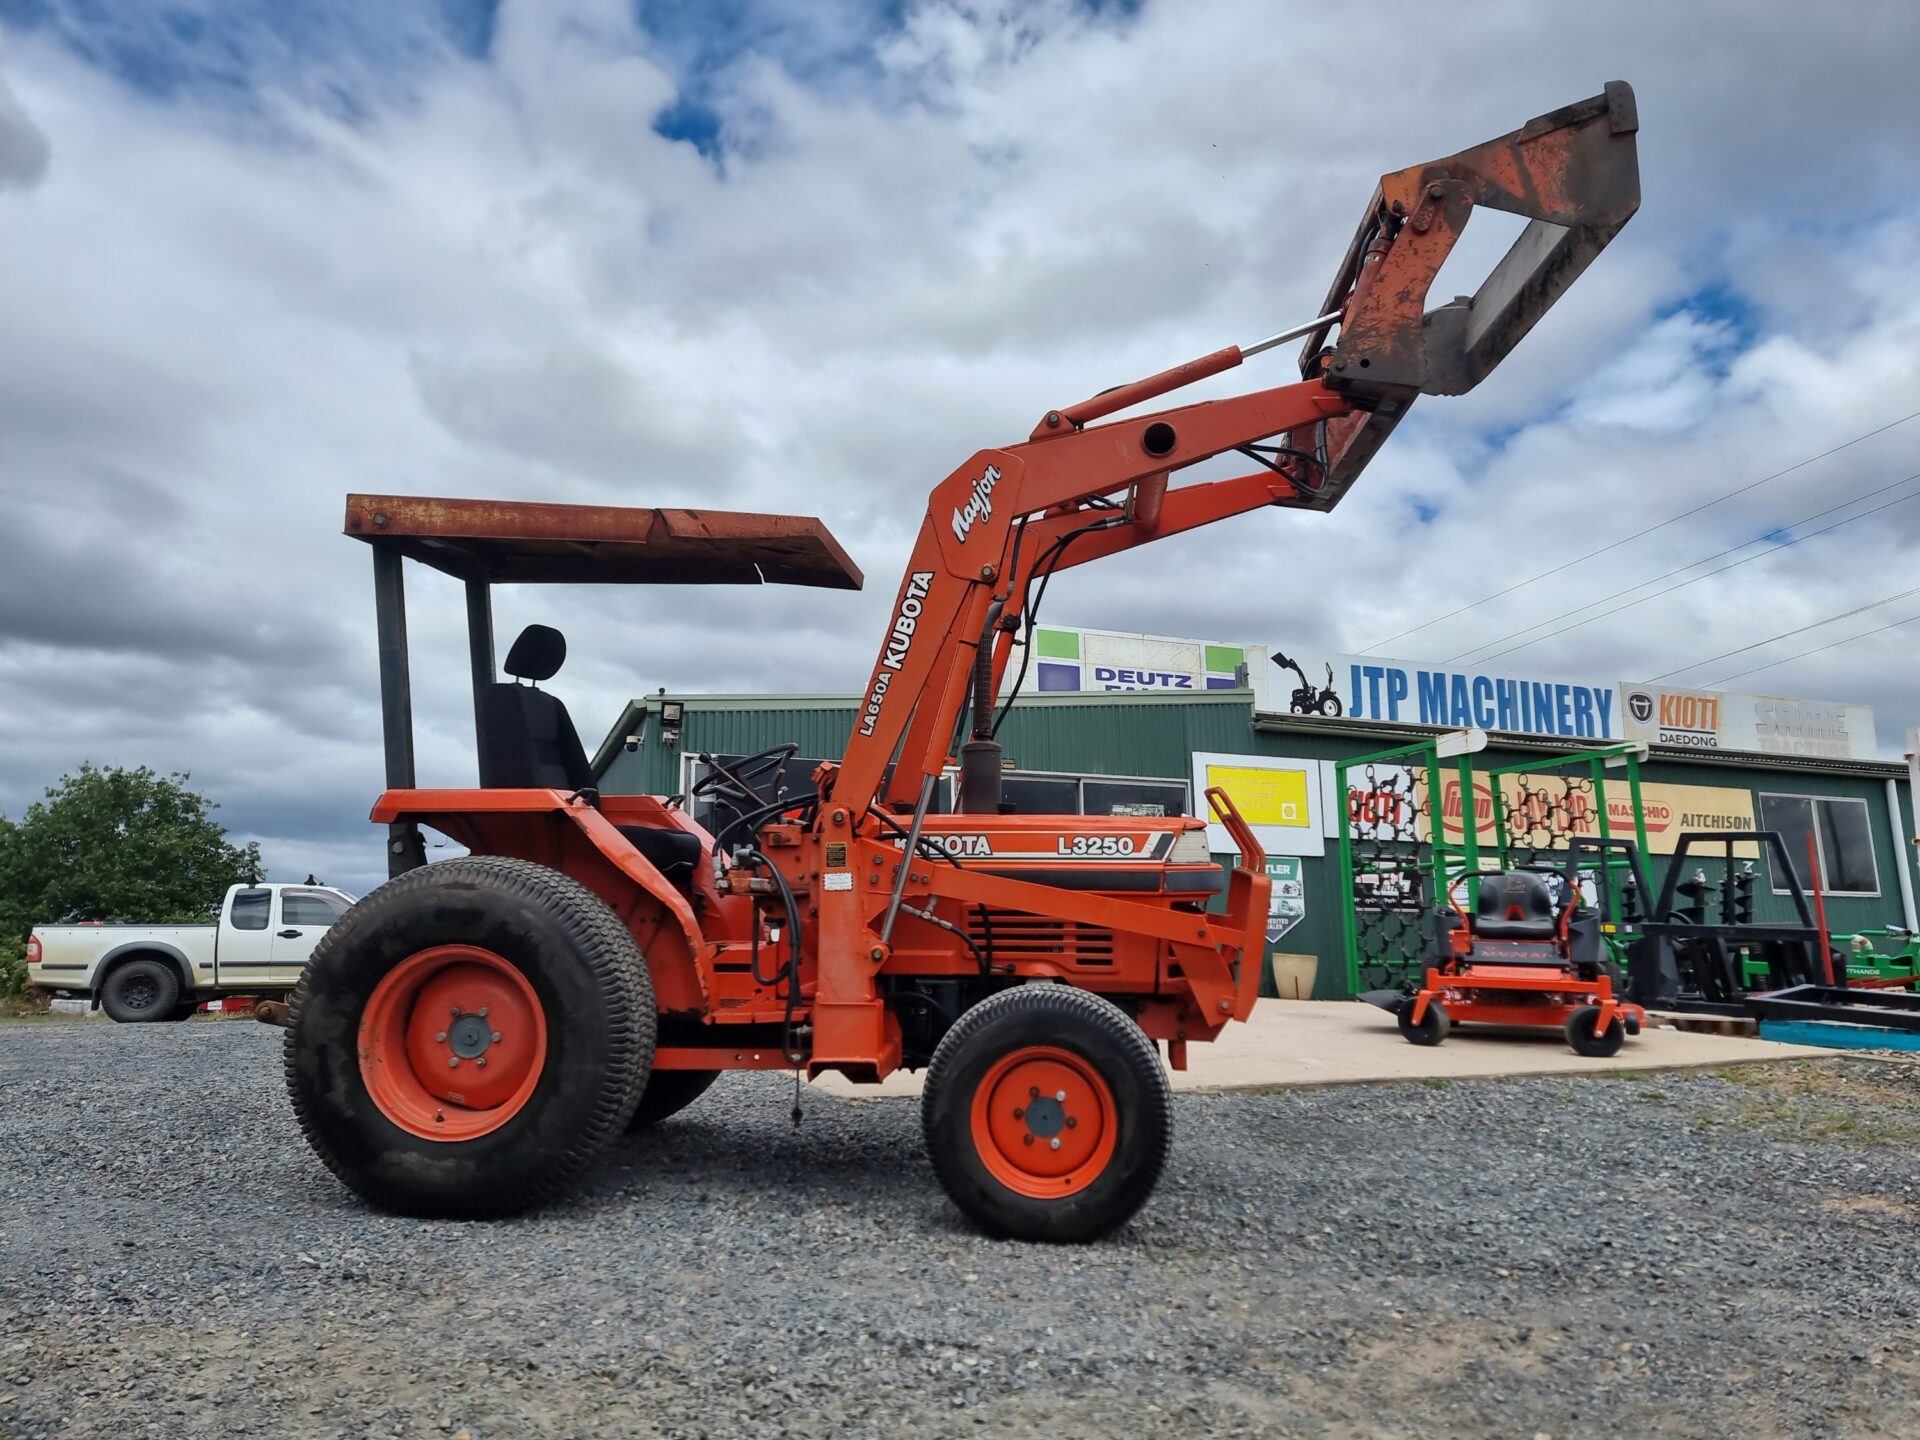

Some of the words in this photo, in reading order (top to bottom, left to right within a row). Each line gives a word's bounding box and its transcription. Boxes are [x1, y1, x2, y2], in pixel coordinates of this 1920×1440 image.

[951, 464, 1001, 543] Nayjon
[883, 571, 935, 671] KUBOTA
[1095, 667, 1192, 688] DEUTZ
[859, 671, 893, 737] LA650A
[1349, 664, 1408, 721] JTP
[1417, 670, 1612, 739] MACHINERY
[1659, 694, 1718, 730] KIOTI
[1659, 732, 1718, 748] DAEDONG
[1680, 812, 1752, 831] AITCHISON
[1057, 835, 1135, 856] L3250
